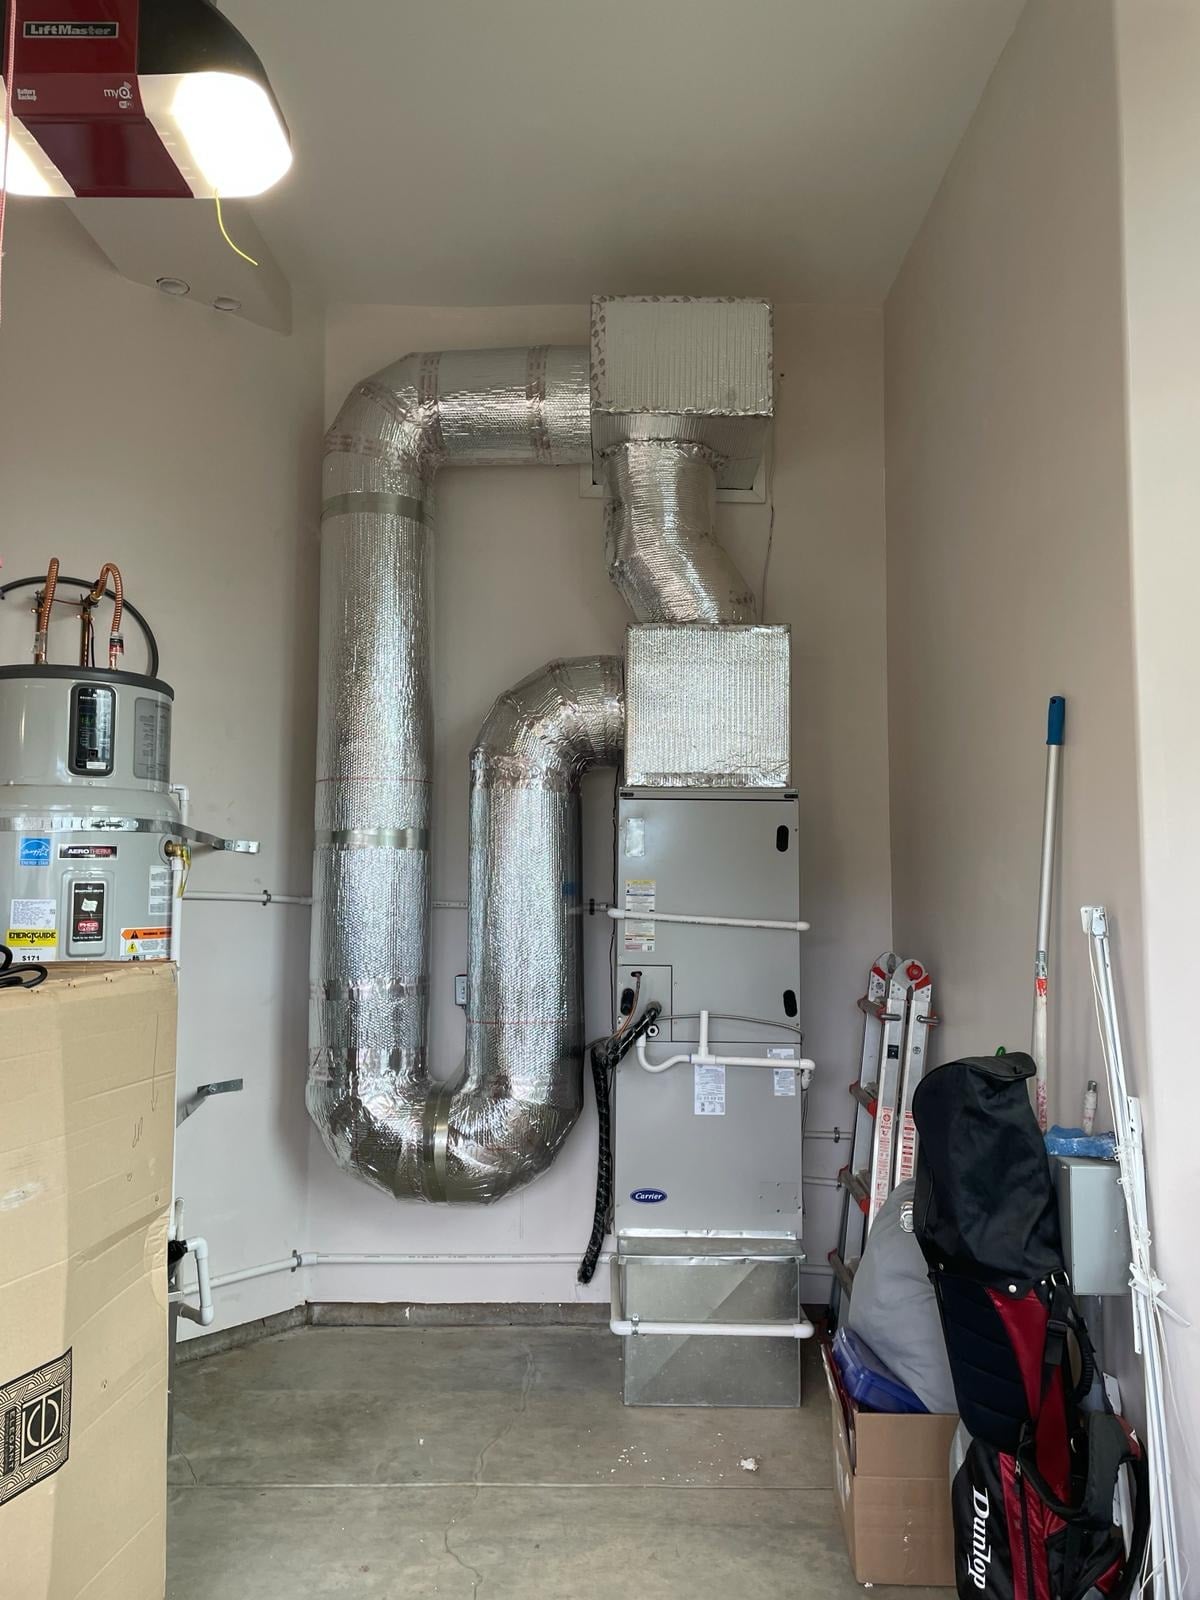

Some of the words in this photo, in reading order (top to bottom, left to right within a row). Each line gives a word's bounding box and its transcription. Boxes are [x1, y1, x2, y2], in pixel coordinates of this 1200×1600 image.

[31, 25, 111, 35] LiftMaster
[104, 86, 133, 99] myQ
[635, 1192, 662, 1200] Carrier
[8, 1411, 16, 1469] ELEGANT
[967, 1485, 991, 1589] Dunlop
